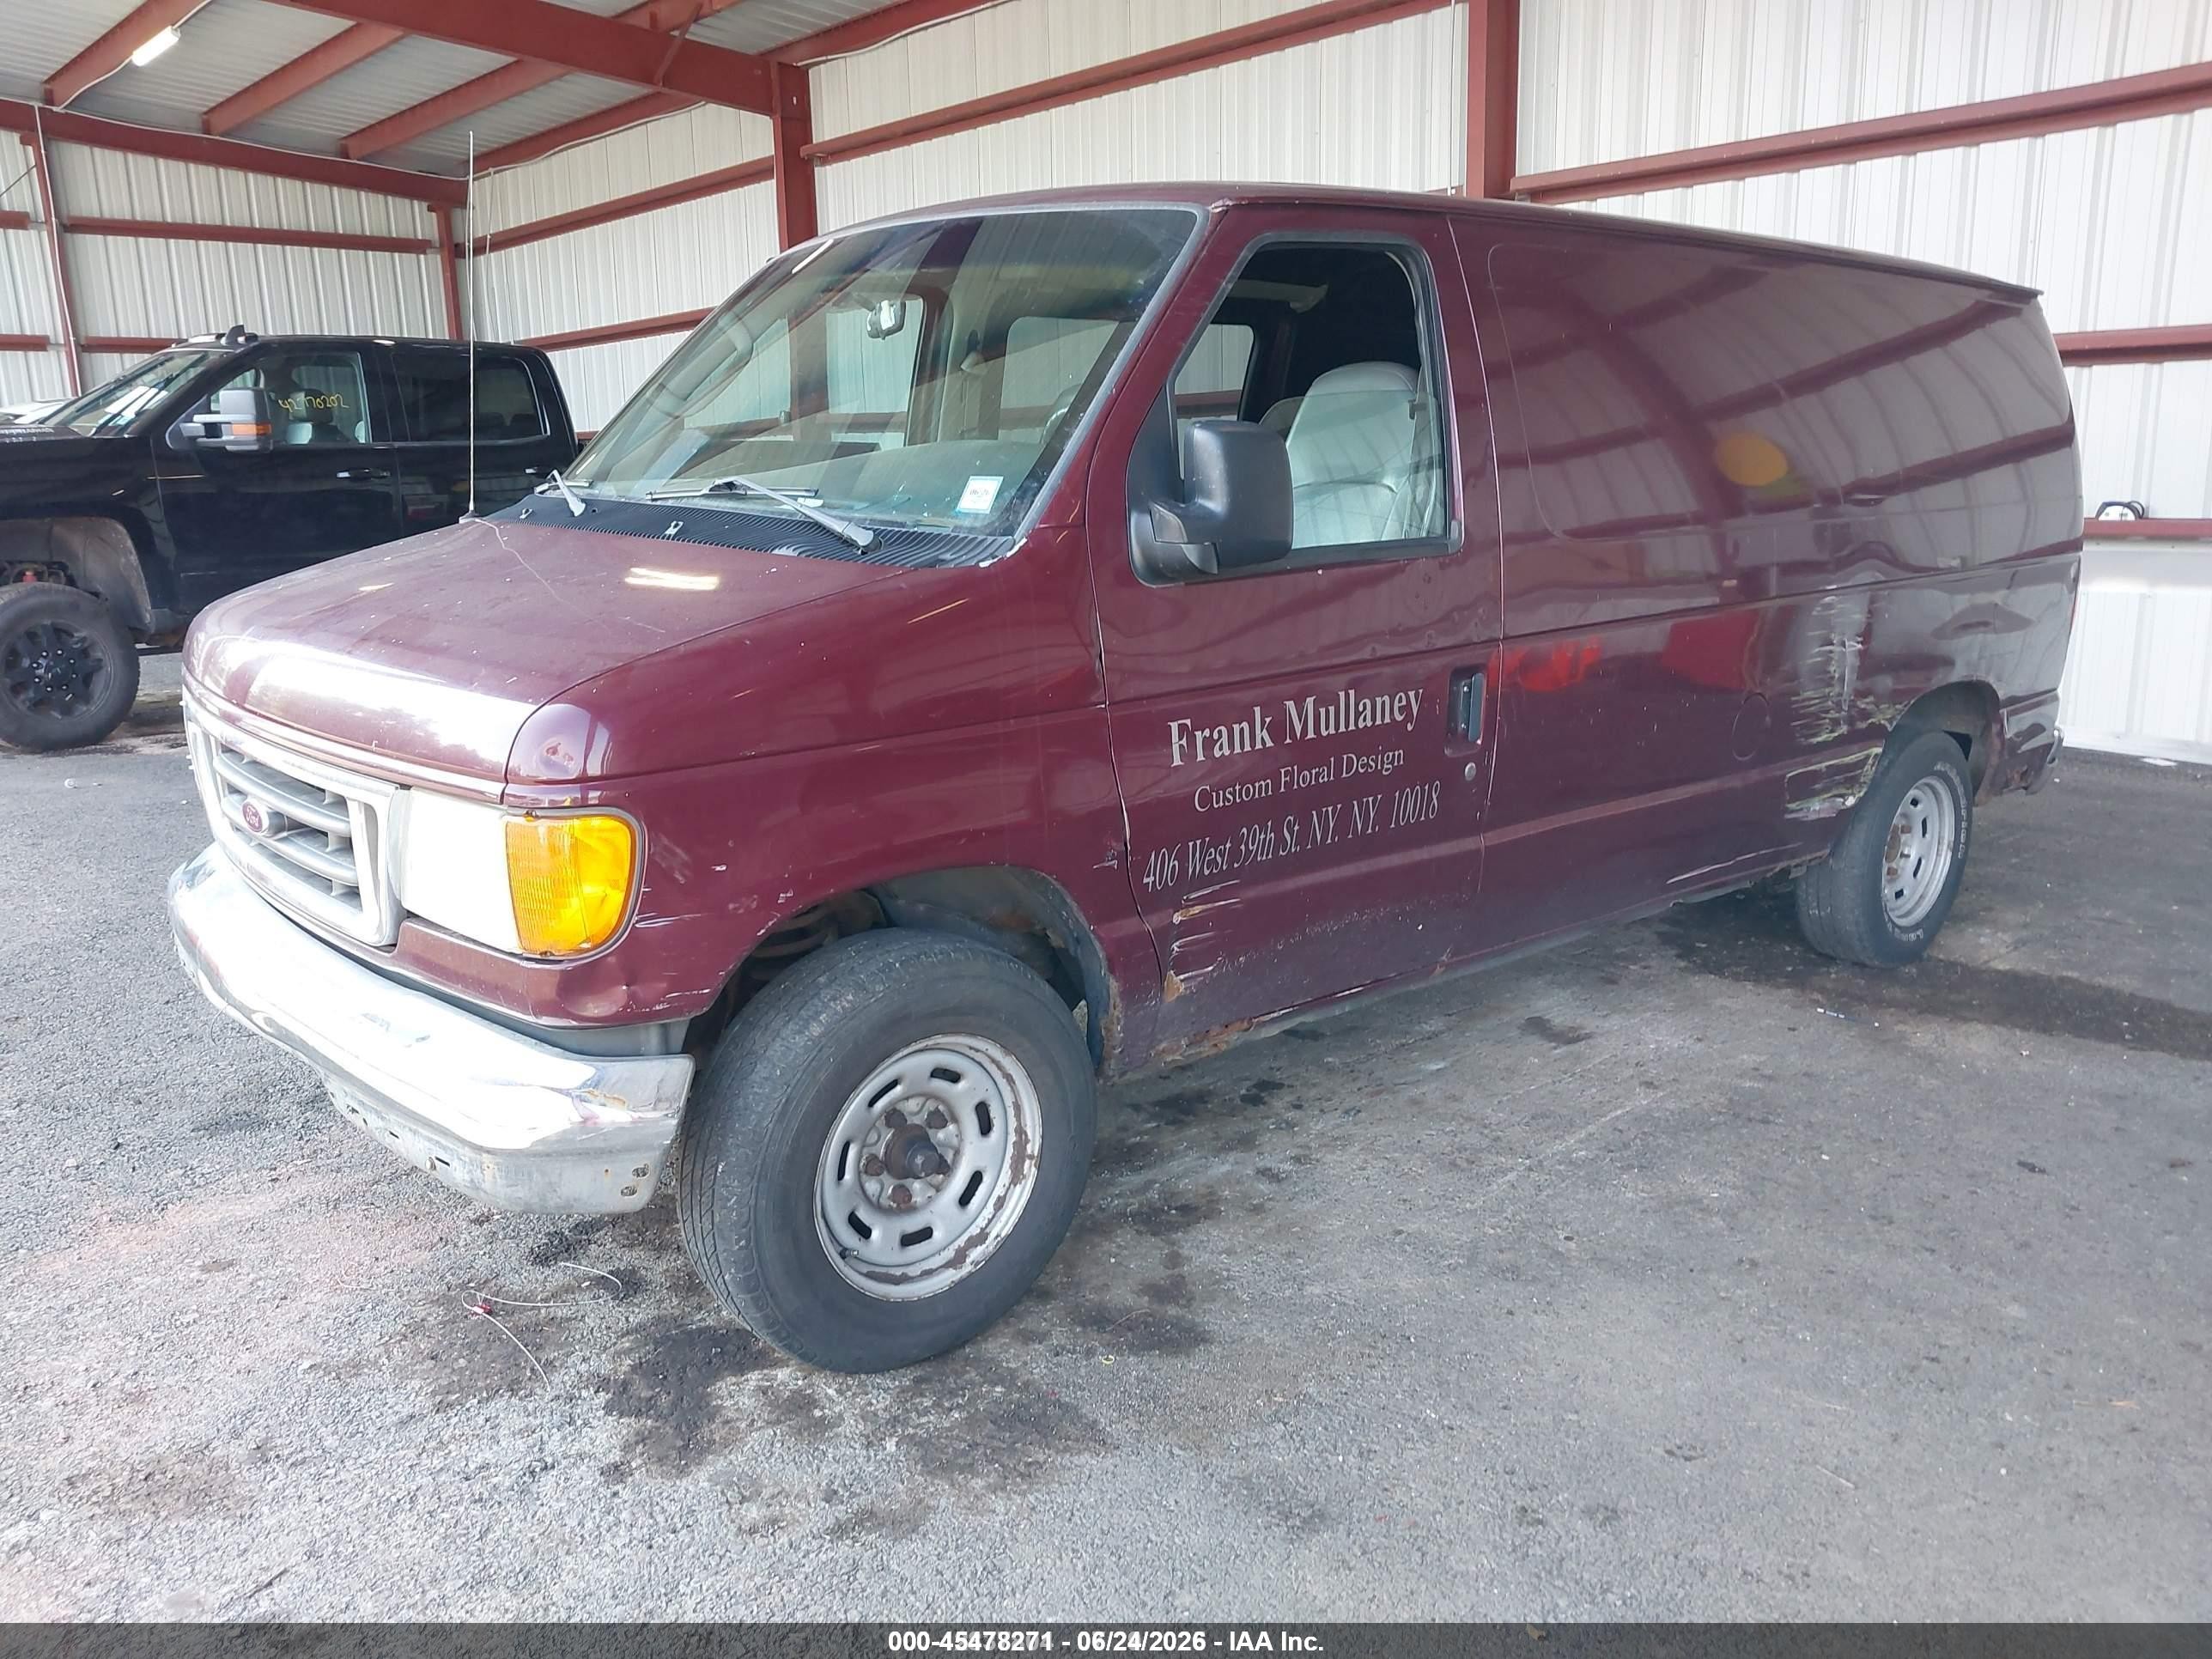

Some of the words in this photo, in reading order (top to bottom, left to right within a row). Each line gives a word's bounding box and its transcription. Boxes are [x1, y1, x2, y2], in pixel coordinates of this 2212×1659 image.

[1168, 707, 1273, 768] Frank
[1284, 689, 1424, 744] Mullaney
[1194, 780, 1273, 811] Custom
[1279, 757, 1335, 793] Floral
[1341, 746, 1405, 779] Design
[1143, 844, 1181, 893] 406
[1187, 836, 1232, 882] West
[1234, 820, 1276, 868] 39th
[1279, 811, 1302, 857] St.
[1307, 804, 1341, 851] NY.
[1347, 794, 1382, 841] NY.
[1389, 780, 1442, 830] 10018
